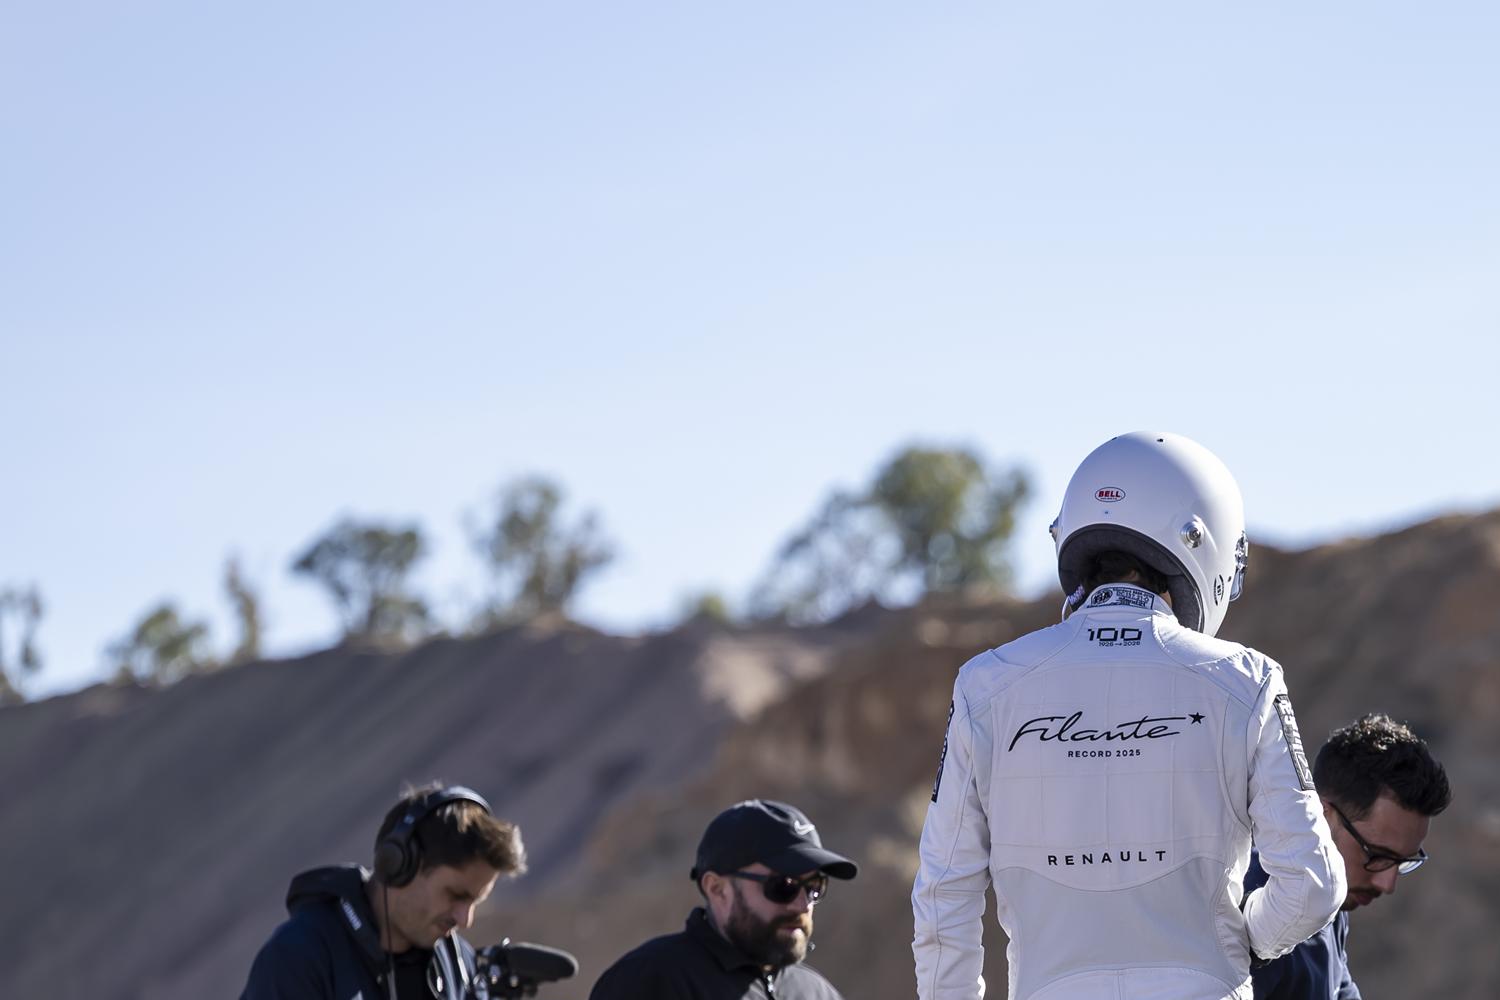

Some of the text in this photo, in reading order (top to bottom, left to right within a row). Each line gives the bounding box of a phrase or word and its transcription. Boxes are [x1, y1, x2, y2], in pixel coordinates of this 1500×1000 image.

[1098, 490, 1121, 498] BELL
[1087, 627, 1143, 642] 100
[1008, 711, 1187, 752] Filante
[1067, 749, 1142, 759] RECORD 2025
[1047, 850, 1167, 866] RENAULT
